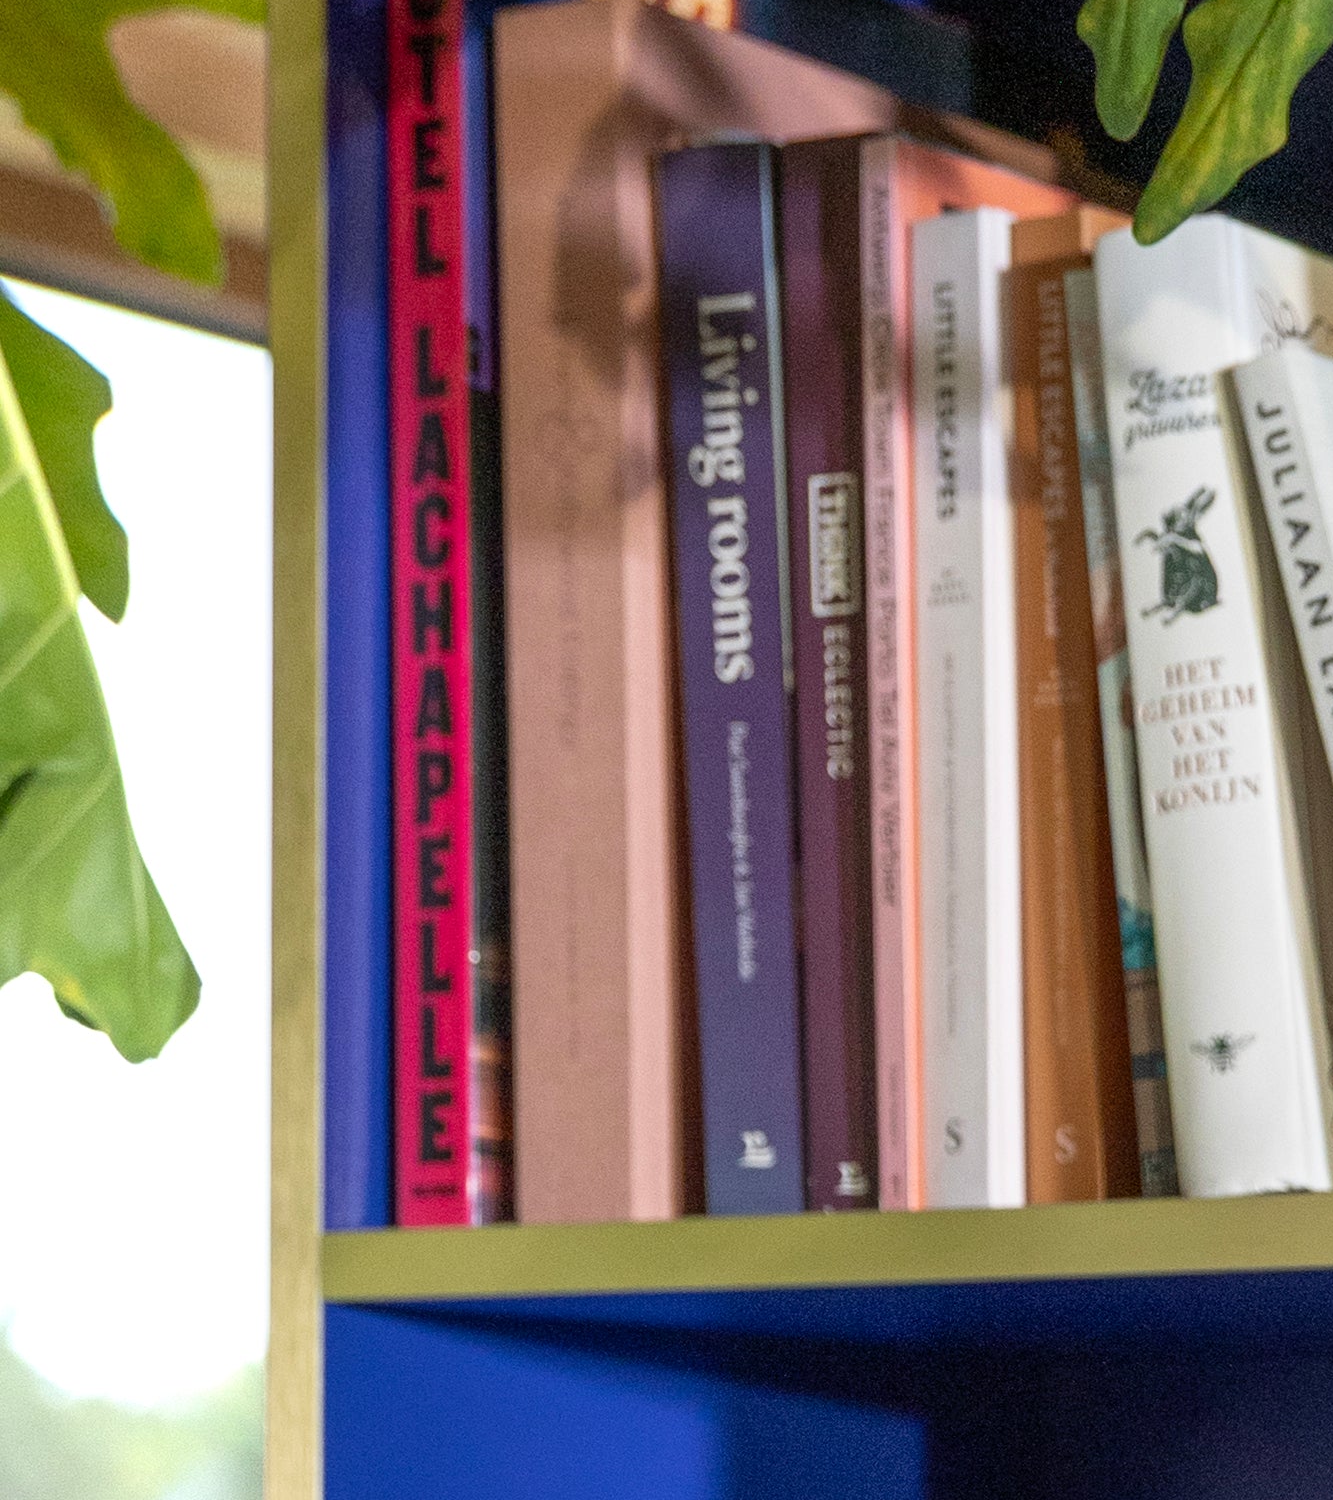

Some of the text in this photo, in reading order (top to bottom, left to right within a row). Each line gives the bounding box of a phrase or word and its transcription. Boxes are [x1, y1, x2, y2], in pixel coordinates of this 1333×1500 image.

[688, 292, 759, 488] Living
[933, 281, 958, 522] LITTLE ESCAPES
[707, 495, 755, 684] rooms
[1257, 400, 1333, 630] JULIAAN
[411, 324, 453, 1163] LACHAPELLE
[822, 624, 854, 781] ECLECTIC
[1140, 683, 1256, 723] GEHEIM
[1164, 657, 1224, 688] HET
[1171, 718, 1230, 747] VAN
[1172, 749, 1232, 779] HET
